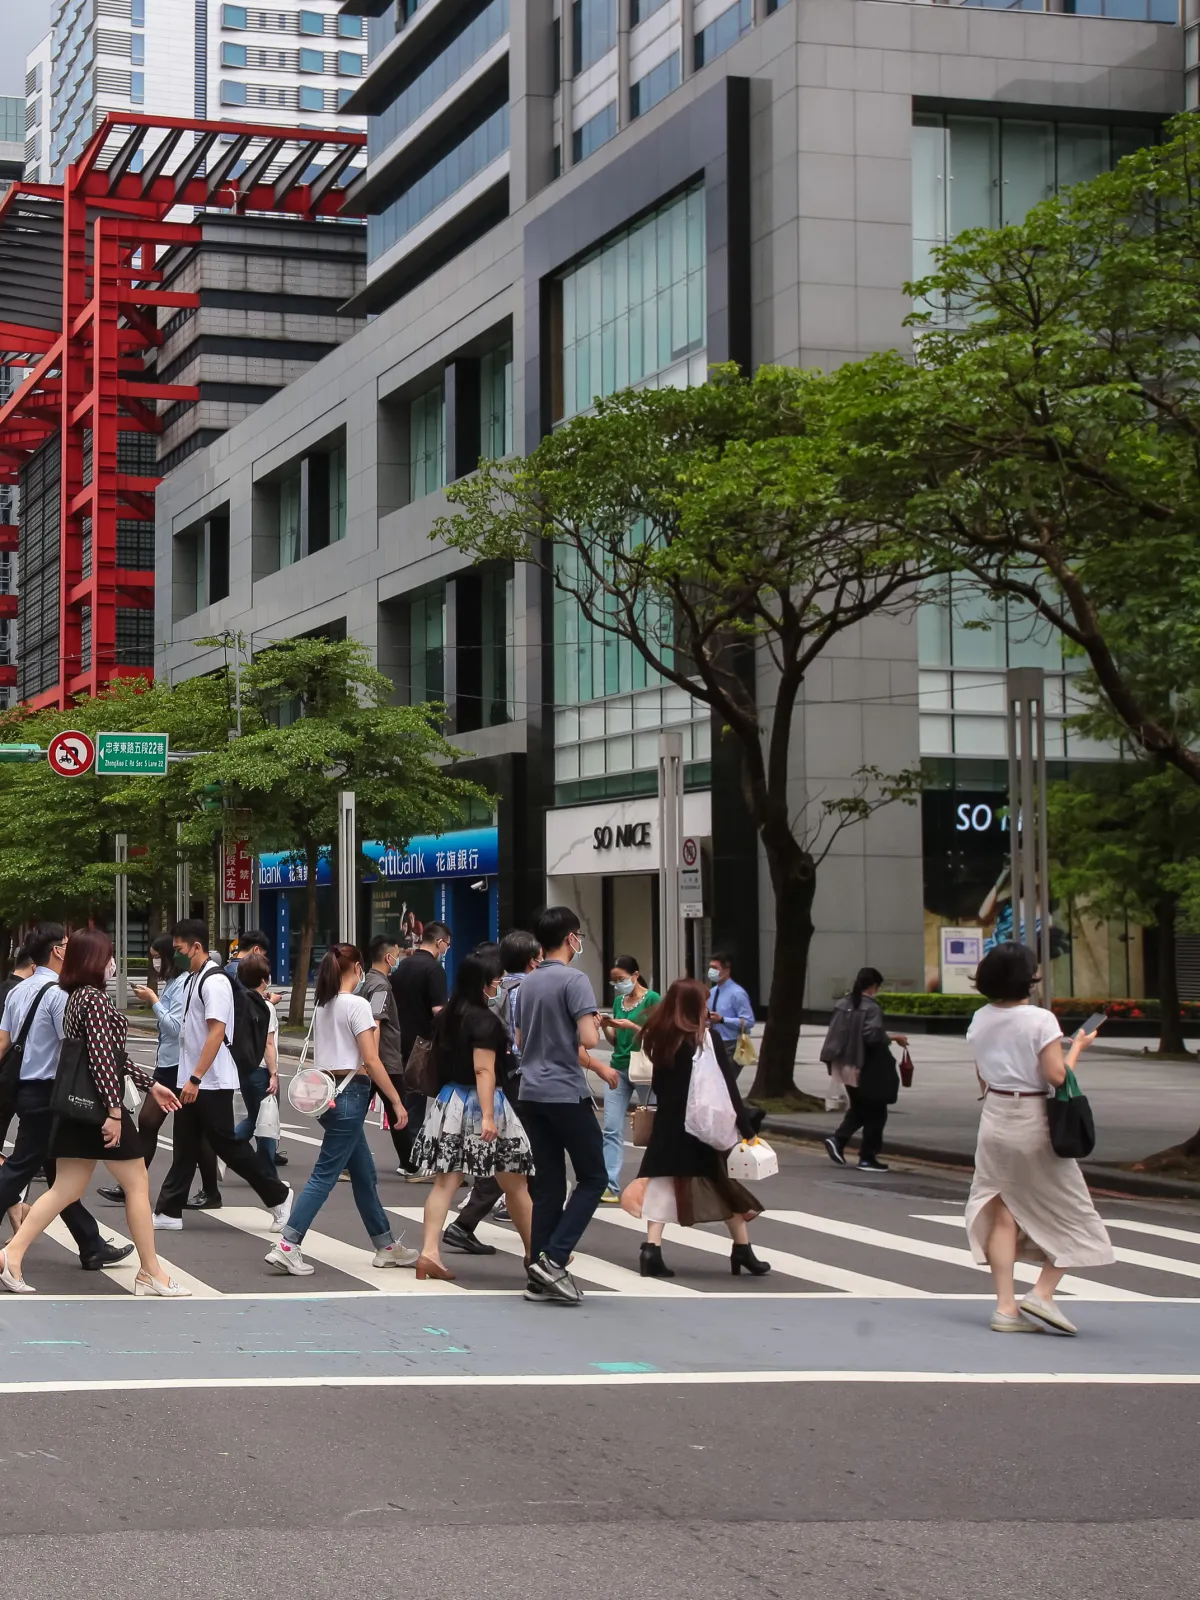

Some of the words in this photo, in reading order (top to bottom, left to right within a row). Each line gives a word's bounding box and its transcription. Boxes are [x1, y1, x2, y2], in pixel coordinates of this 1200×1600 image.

[105, 741, 164, 755] 忠孝東路五段22巷
[158, 760, 164, 768] 22
[956, 803, 993, 831] SO
[593, 826, 613, 850] SO
[616, 822, 651, 848] NICE
[378, 847, 426, 876] citibank
[435, 848, 479, 872] 花旗銀行
